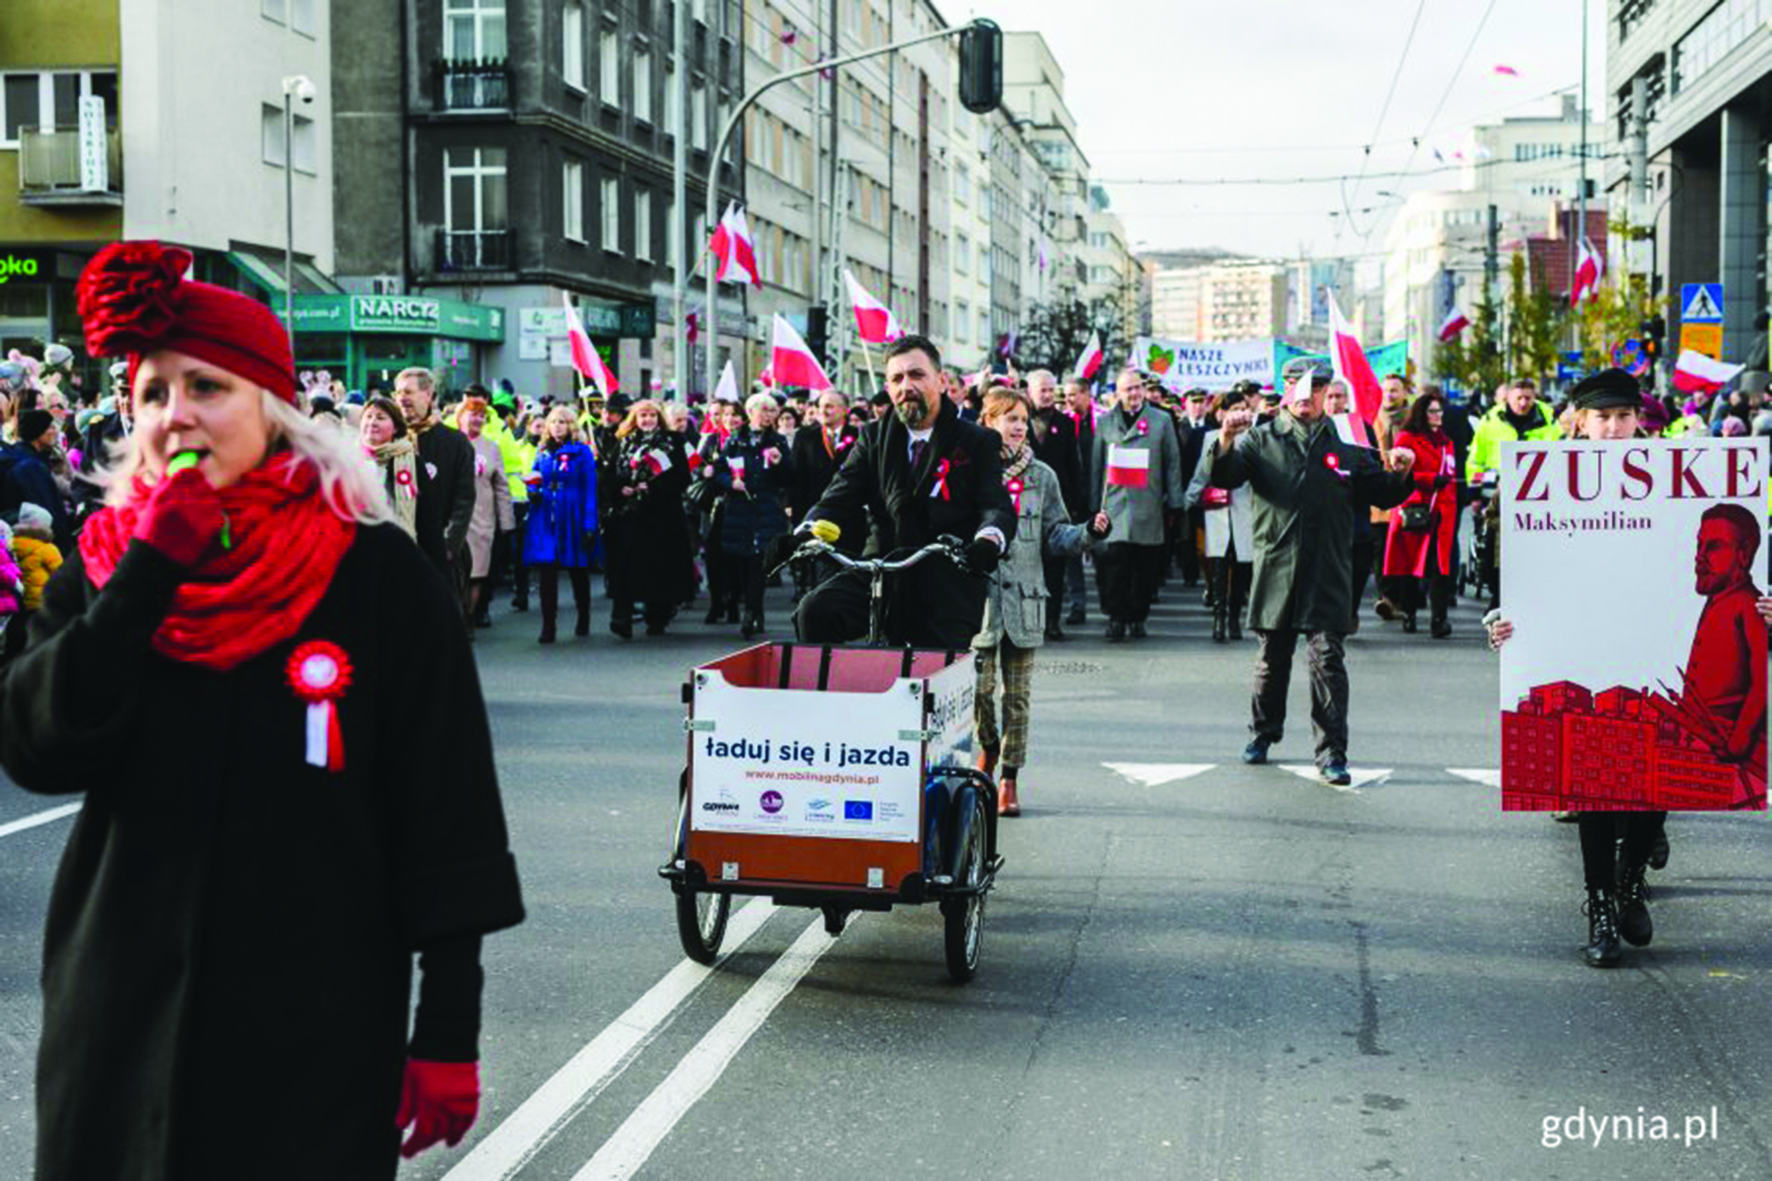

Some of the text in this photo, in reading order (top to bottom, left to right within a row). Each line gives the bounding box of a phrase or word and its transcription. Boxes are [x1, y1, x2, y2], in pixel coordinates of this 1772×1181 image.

[360, 299, 440, 319] NARCYZ
[1179, 348, 1223, 361] NASZE
[1178, 358, 1269, 376] LESZCZYNKI
[1515, 447, 1761, 502] ZUSKE
[1514, 511, 1652, 537] Maksymilian
[705, 736, 910, 767] ładuj się i jazda
[745, 770, 879, 785] www.mobilnagdynia.pl
